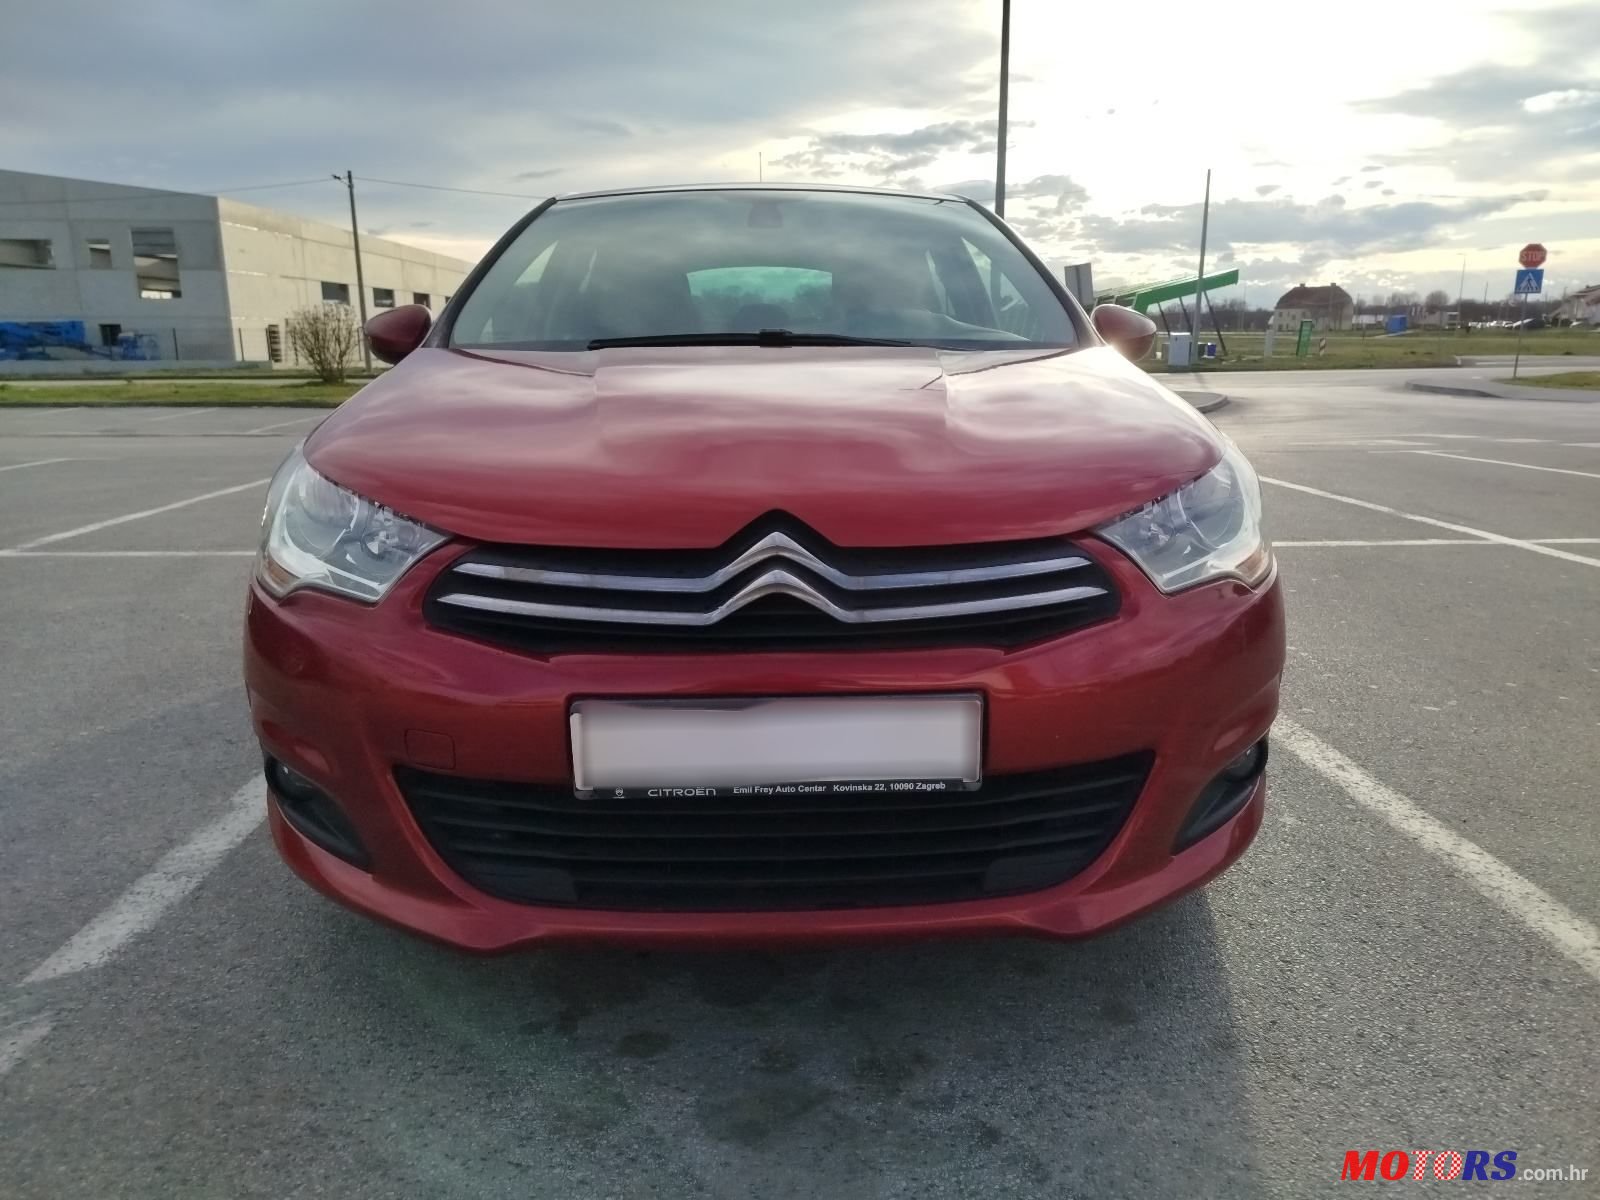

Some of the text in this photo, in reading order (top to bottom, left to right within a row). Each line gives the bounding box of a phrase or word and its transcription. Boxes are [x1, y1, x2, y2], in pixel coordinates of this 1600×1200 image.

[1521, 250, 1545, 262] STOP
[647, 786, 716, 797] CITROËN
[733, 781, 946, 795] Emil Frey Auto Centar Kovinska 22, 10090 Zagreb
